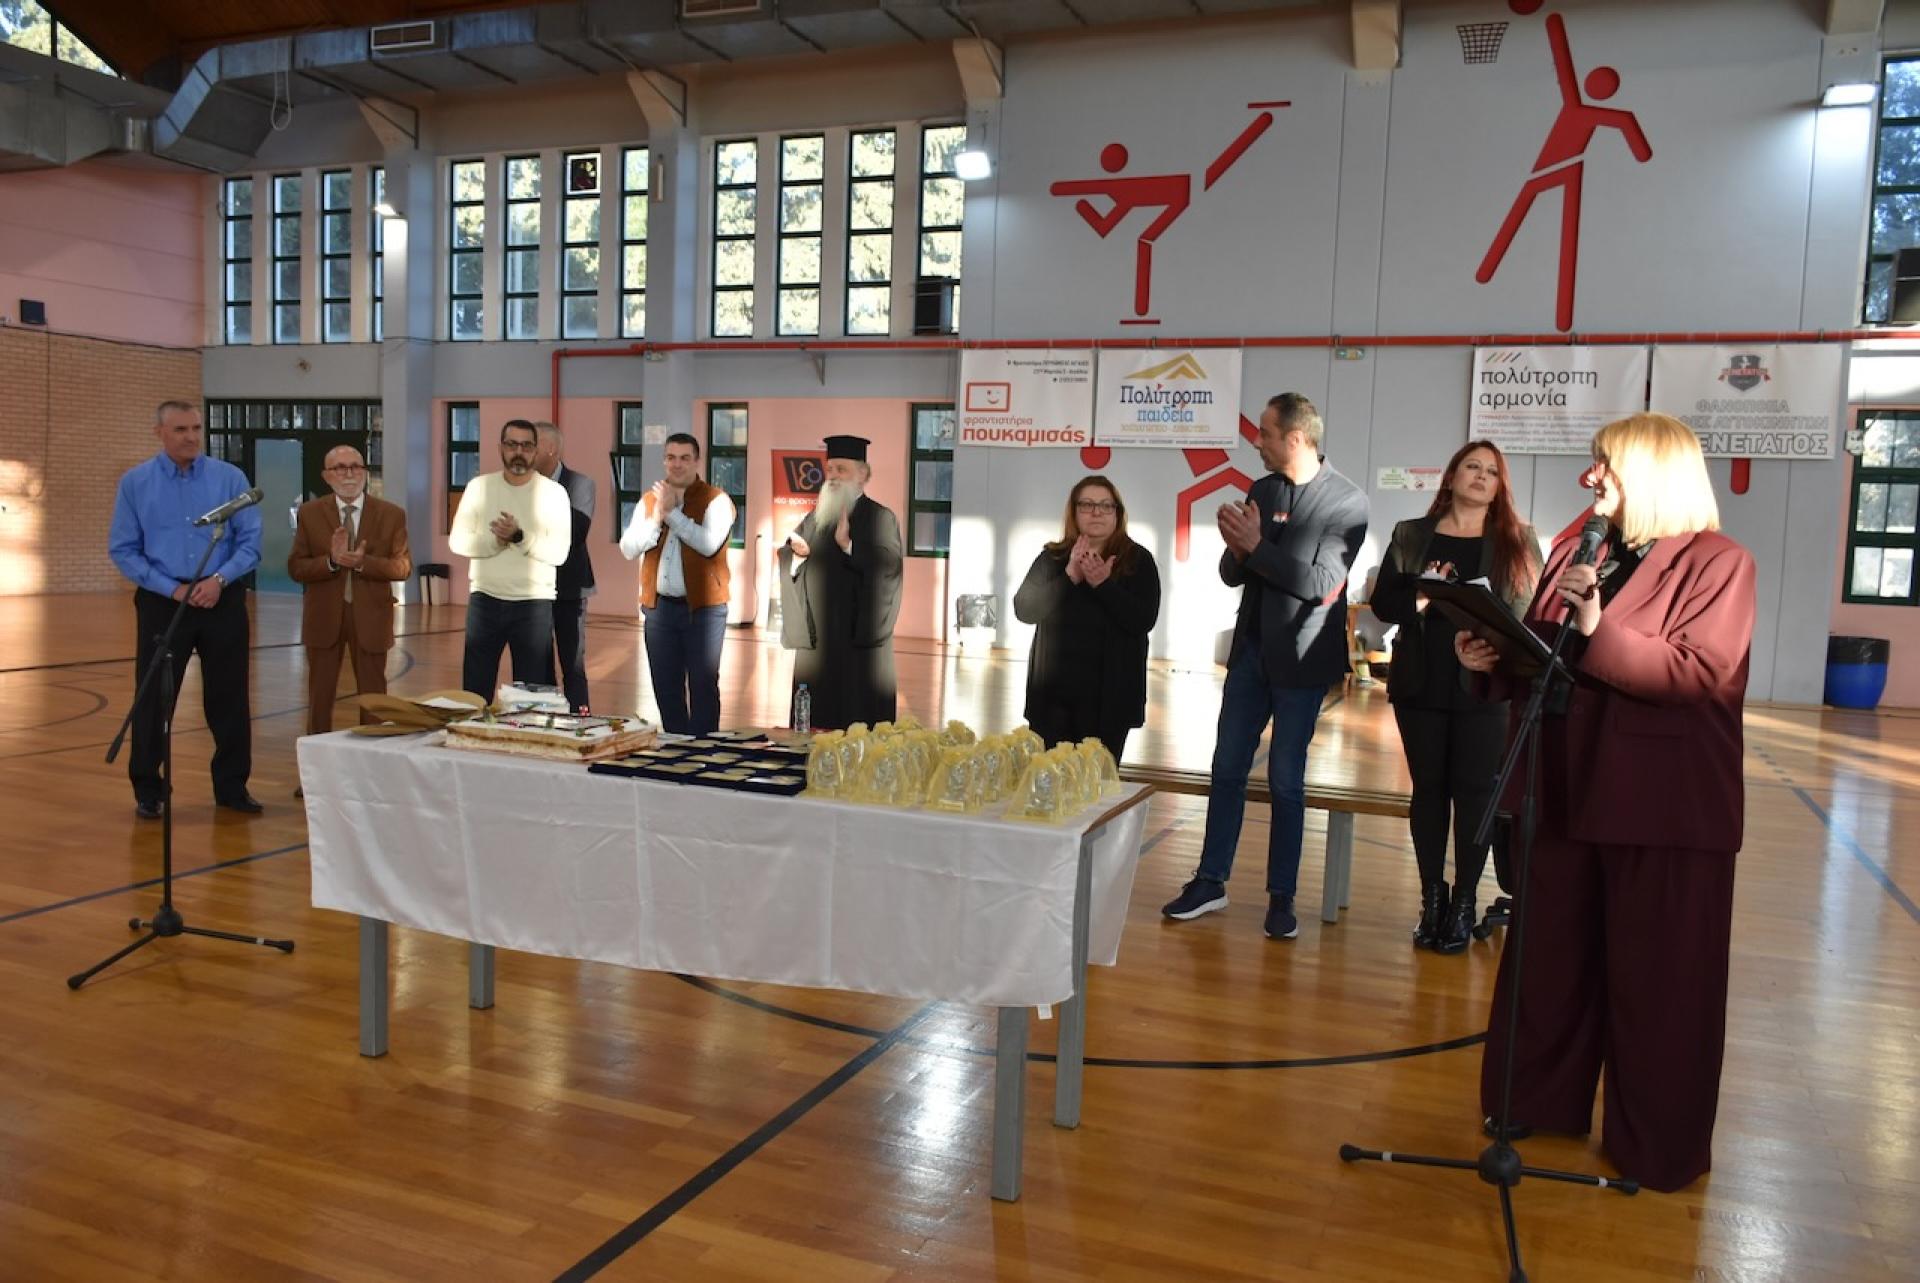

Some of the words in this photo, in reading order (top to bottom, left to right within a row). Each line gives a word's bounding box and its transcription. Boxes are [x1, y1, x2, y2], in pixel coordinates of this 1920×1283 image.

[1481, 366, 1598, 388] πολύτροπη
[1120, 383, 1213, 407] Πολύτροπη
[1479, 388, 1567, 409] αρμονία
[1137, 404, 1194, 422] παιδεία
[962, 424, 1085, 446] πουκαμισάς
[1695, 432, 1829, 455] ΕΝΕΤΑΤΟΣ
